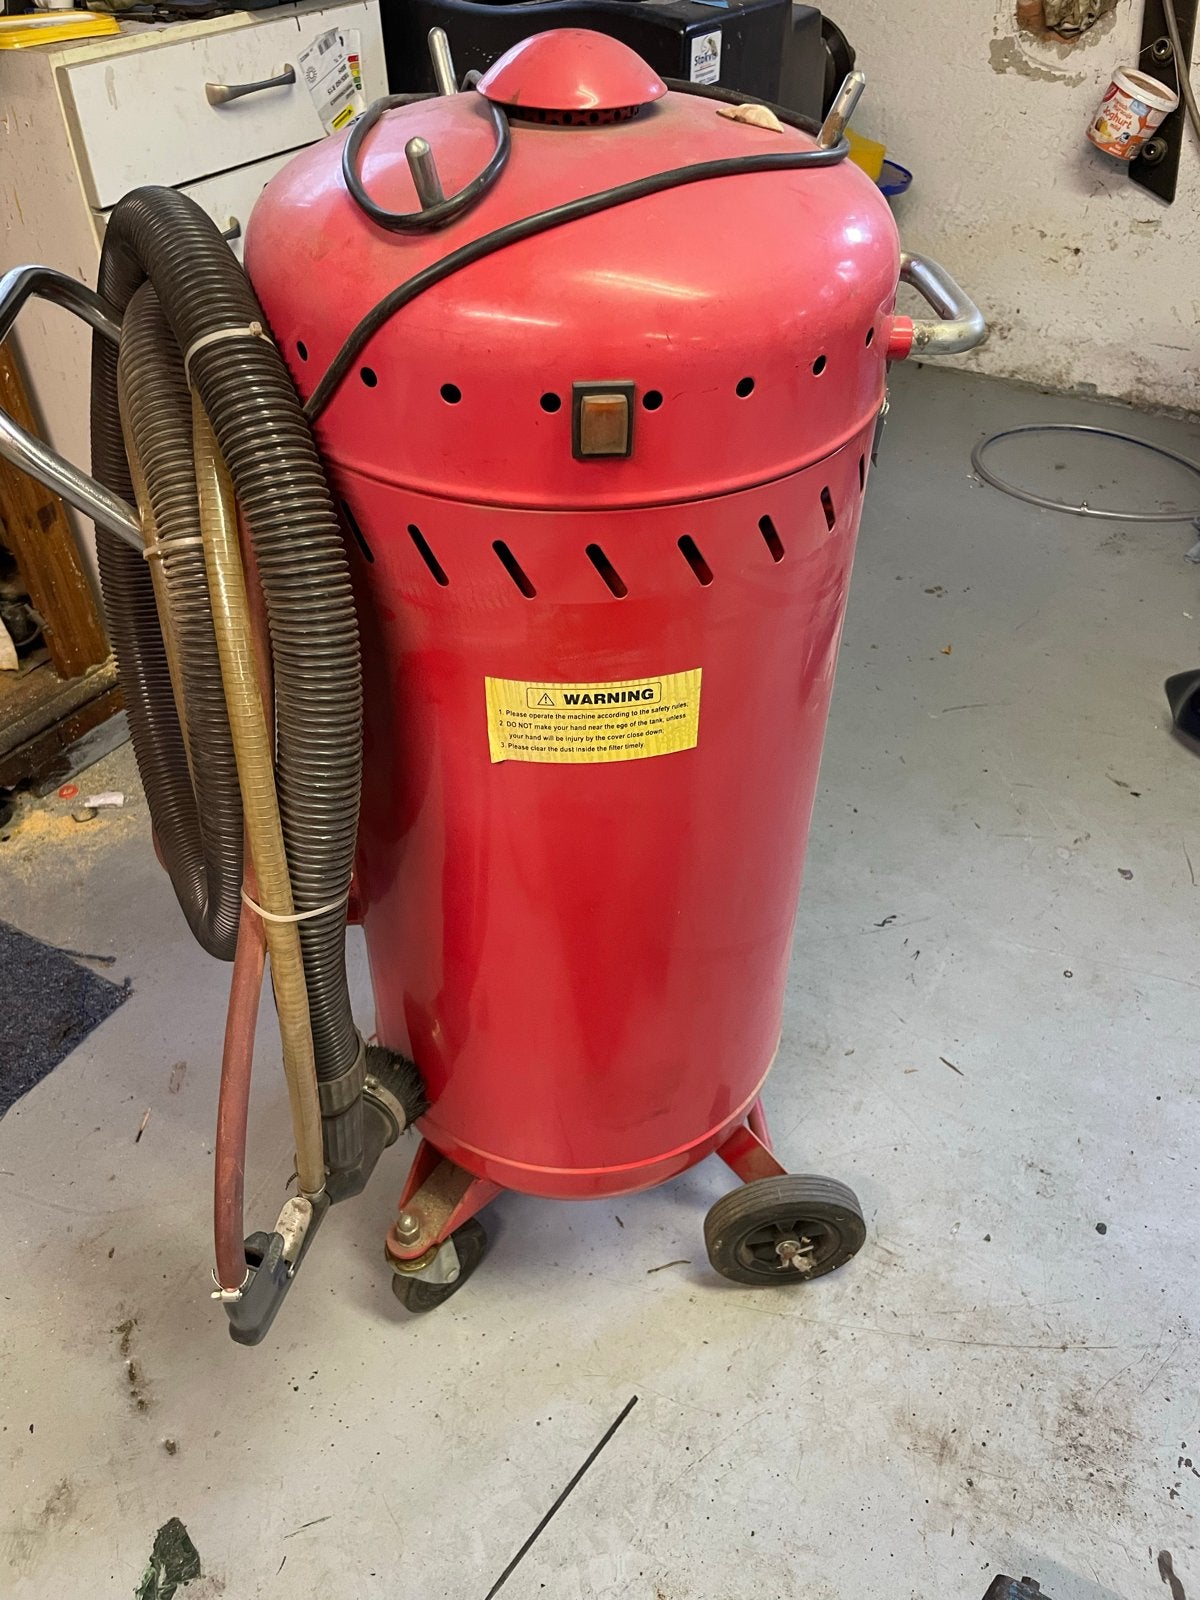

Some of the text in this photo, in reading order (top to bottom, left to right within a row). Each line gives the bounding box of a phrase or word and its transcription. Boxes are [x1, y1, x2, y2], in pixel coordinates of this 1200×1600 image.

[563, 688, 654, 705] WARNING
[506, 709, 527, 718] Please
[597, 710, 630, 719] according
[651, 704, 670, 713] safety
[570, 723, 586, 731] hand
[666, 713, 686, 722] unless
[565, 735, 584, 743] injury
[607, 733, 625, 741] cover
[627, 731, 644, 739] close
[508, 742, 529, 751] Please
[608, 743, 624, 751] filter
